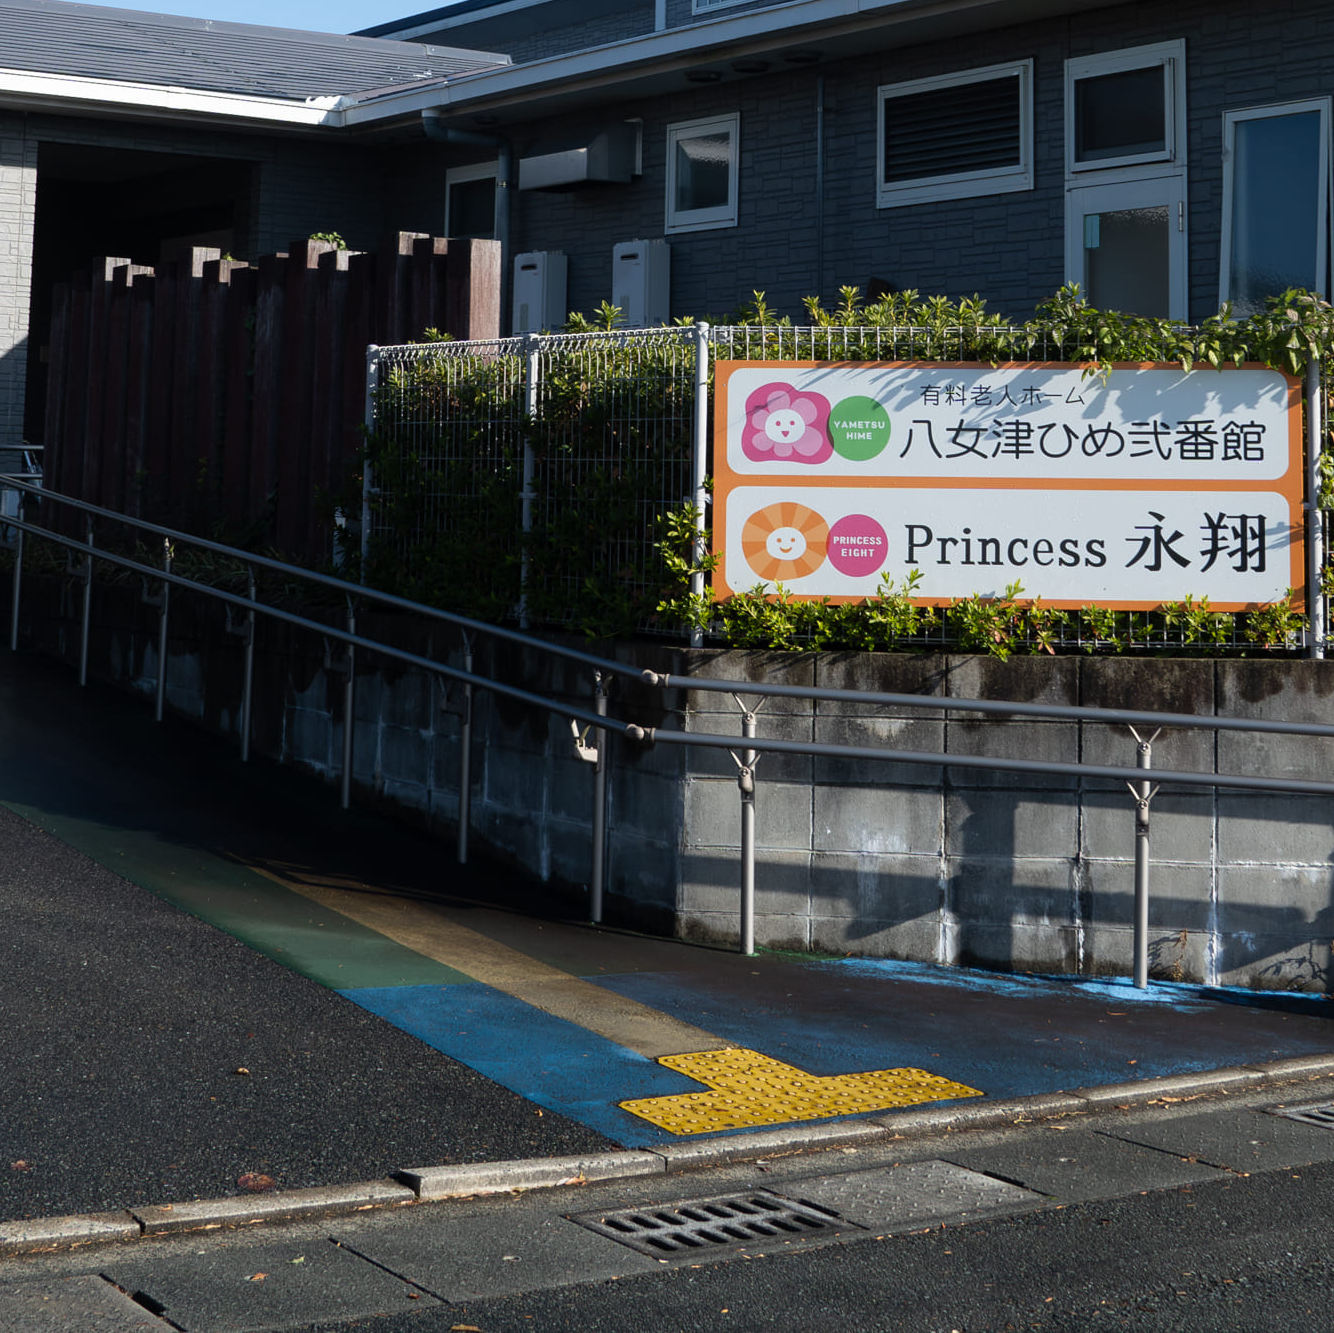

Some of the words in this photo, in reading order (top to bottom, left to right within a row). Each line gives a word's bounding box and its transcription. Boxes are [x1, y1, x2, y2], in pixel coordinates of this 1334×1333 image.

[920, 384, 1085, 407] 有料老人ホーム
[833, 420, 886, 430] YAMETSU
[845, 431, 873, 441] HIME
[899, 418, 1267, 461] 八女津ひめ弐番館
[832, 535, 883, 546] PRINCESS
[905, 524, 1107, 567] Princess
[1125, 511, 1267, 573] 永翔
[840, 548, 875, 558] EIGHT
